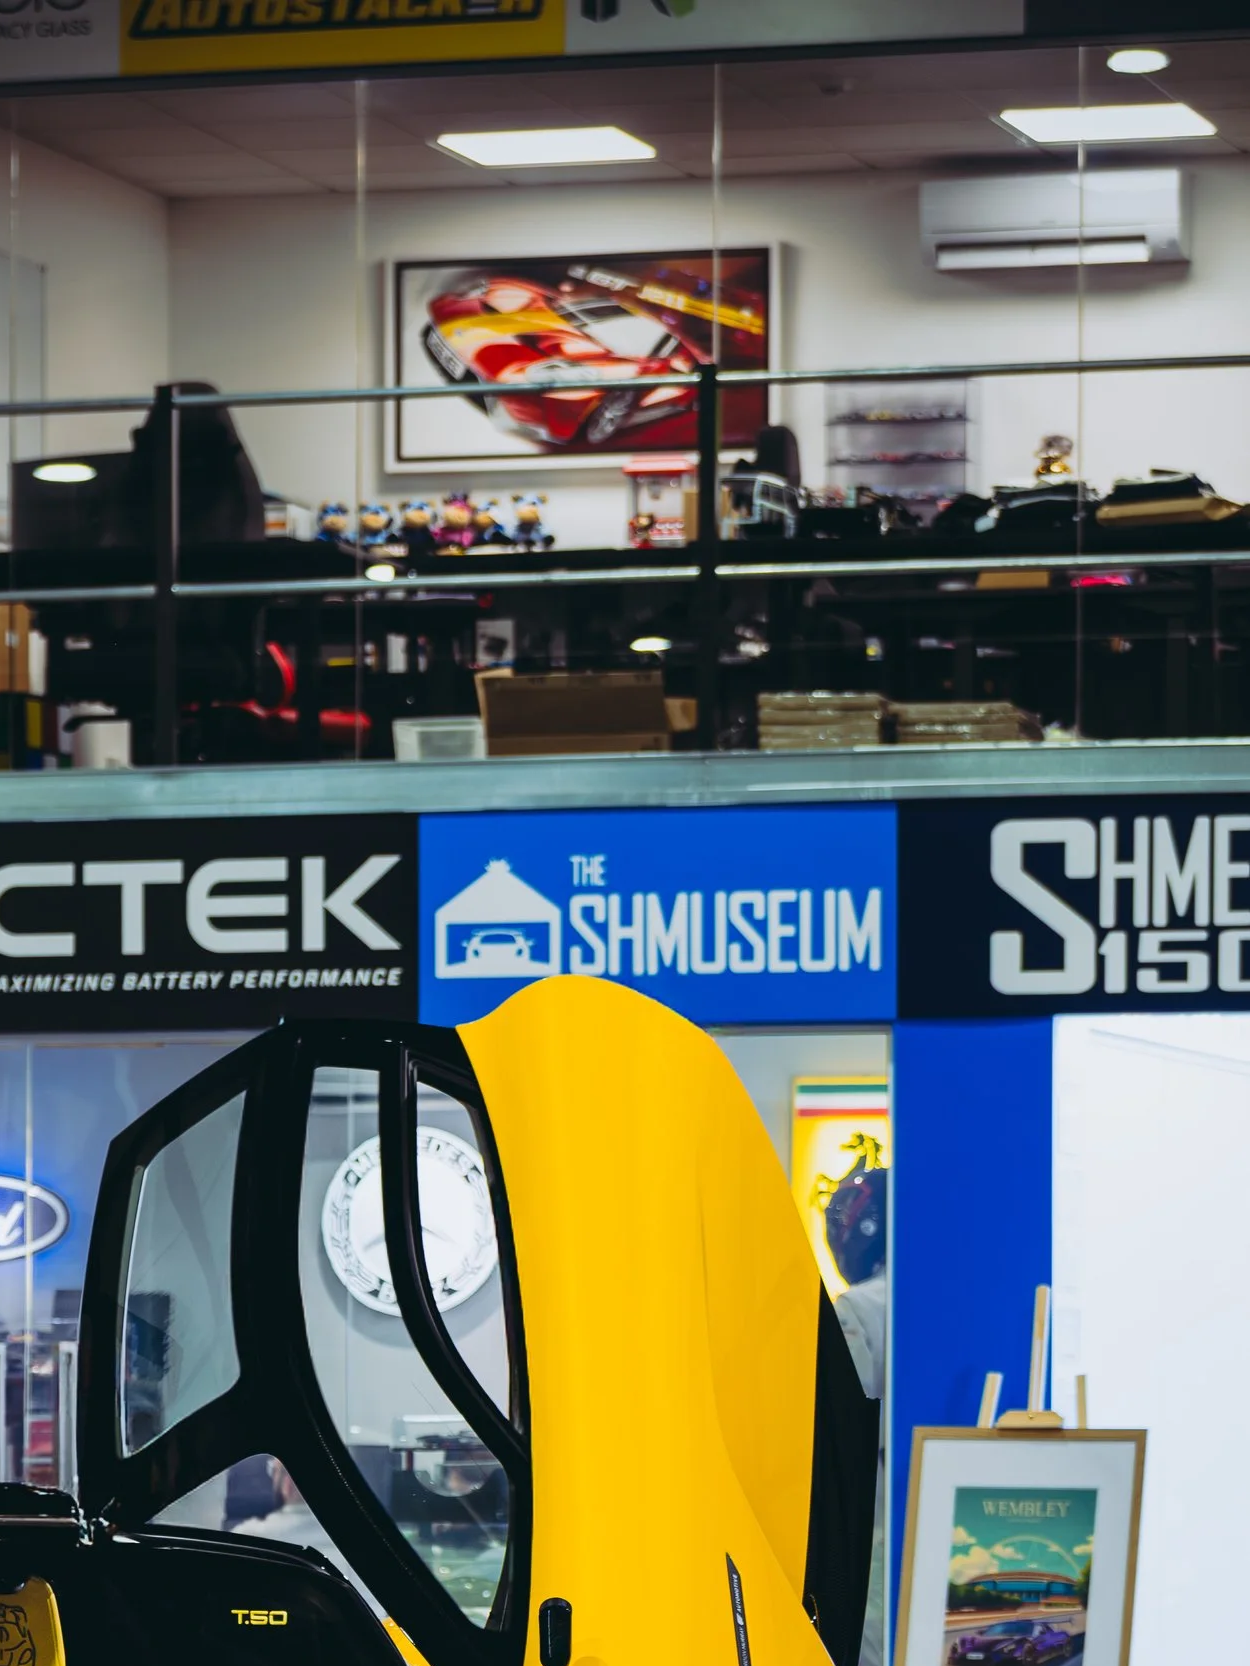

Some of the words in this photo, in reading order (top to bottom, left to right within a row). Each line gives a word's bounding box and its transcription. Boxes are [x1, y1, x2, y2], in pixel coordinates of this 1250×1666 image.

[36, 20, 91, 38] GLASS
[570, 855, 606, 886] THE
[569, 889, 881, 976] SHMUSEUM
[122, 971, 223, 990] BATTERY
[229, 968, 402, 988] PERFORMANCE
[982, 1500, 1069, 1518] WEMBLEY
[230, 1609, 288, 1626] T.50
